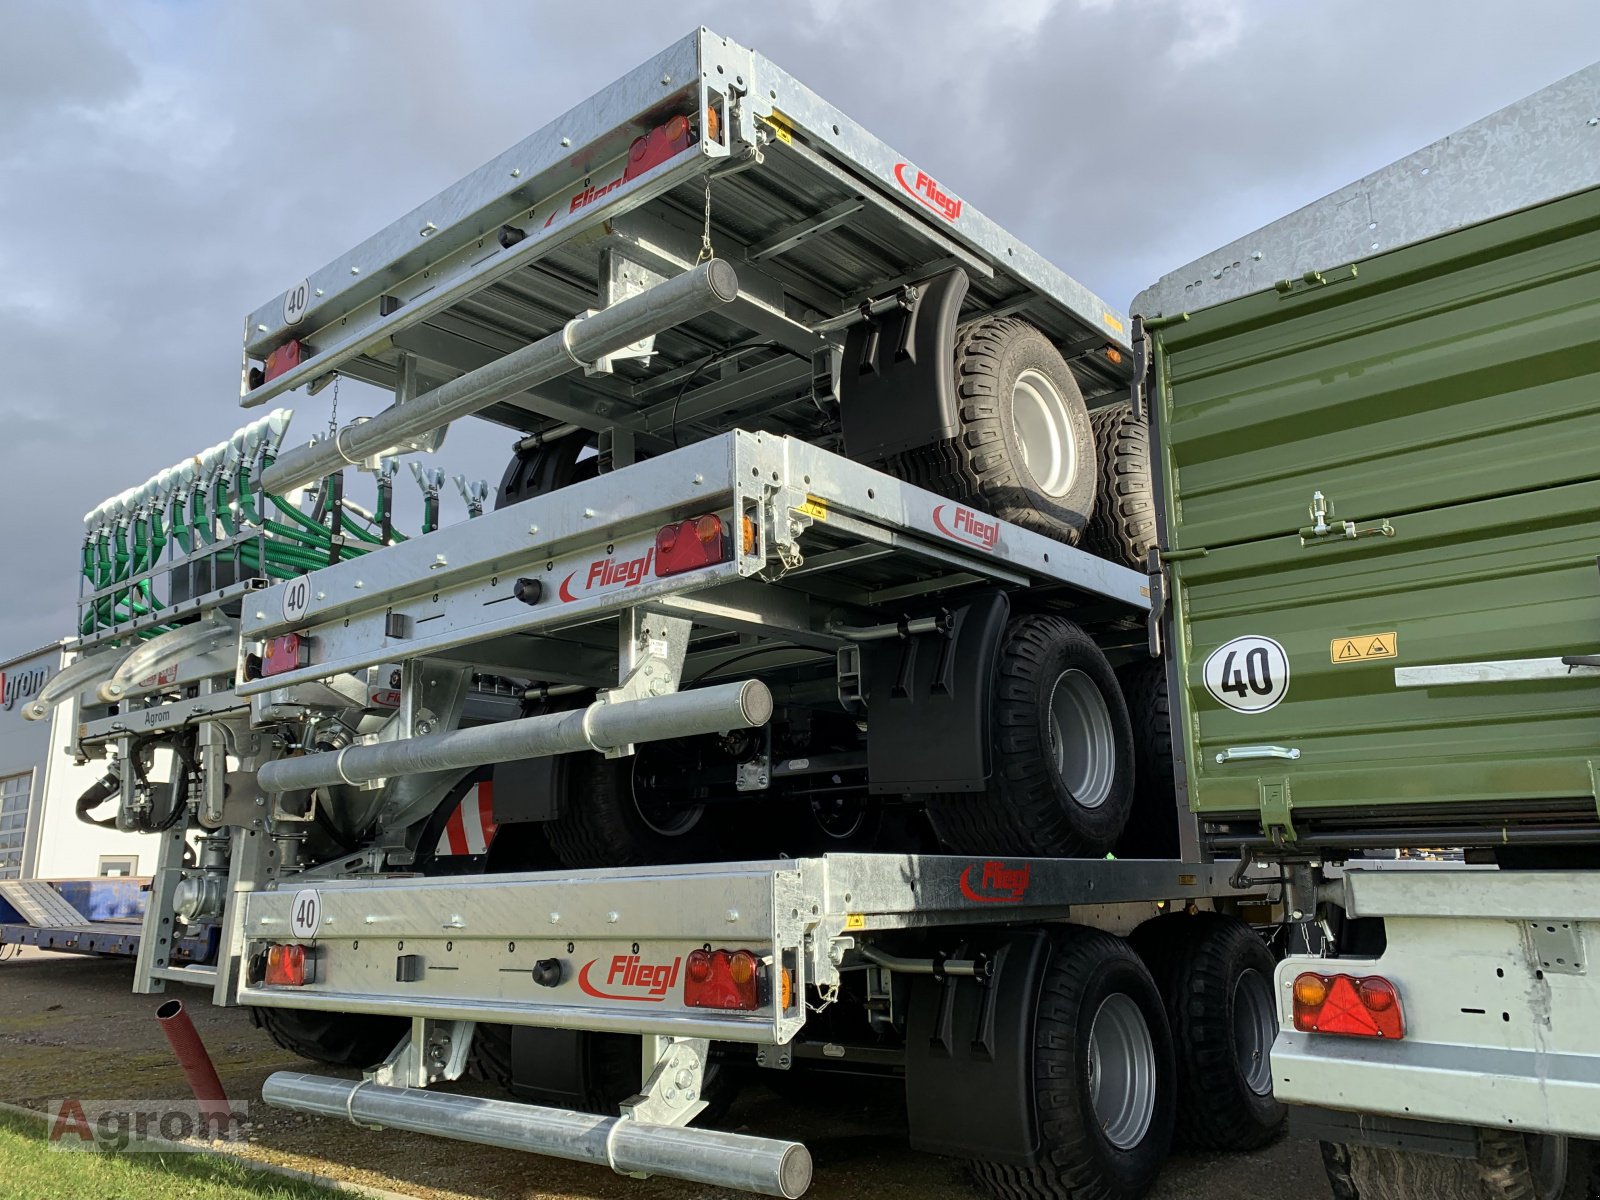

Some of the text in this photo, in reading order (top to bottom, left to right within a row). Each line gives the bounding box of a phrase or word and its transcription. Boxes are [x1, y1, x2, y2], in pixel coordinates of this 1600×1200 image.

[916, 171, 962, 219] Fliegl
[288, 286, 305, 314] 40
[954, 506, 1000, 547] Fliegl
[586, 547, 655, 587] Fliegl
[288, 583, 305, 611] 40
[1221, 647, 1273, 698] 40
[145, 710, 170, 727] Agrom
[982, 861, 1030, 896] Fliegl
[296, 899, 316, 928] 40
[607, 956, 682, 995] Fliegl
